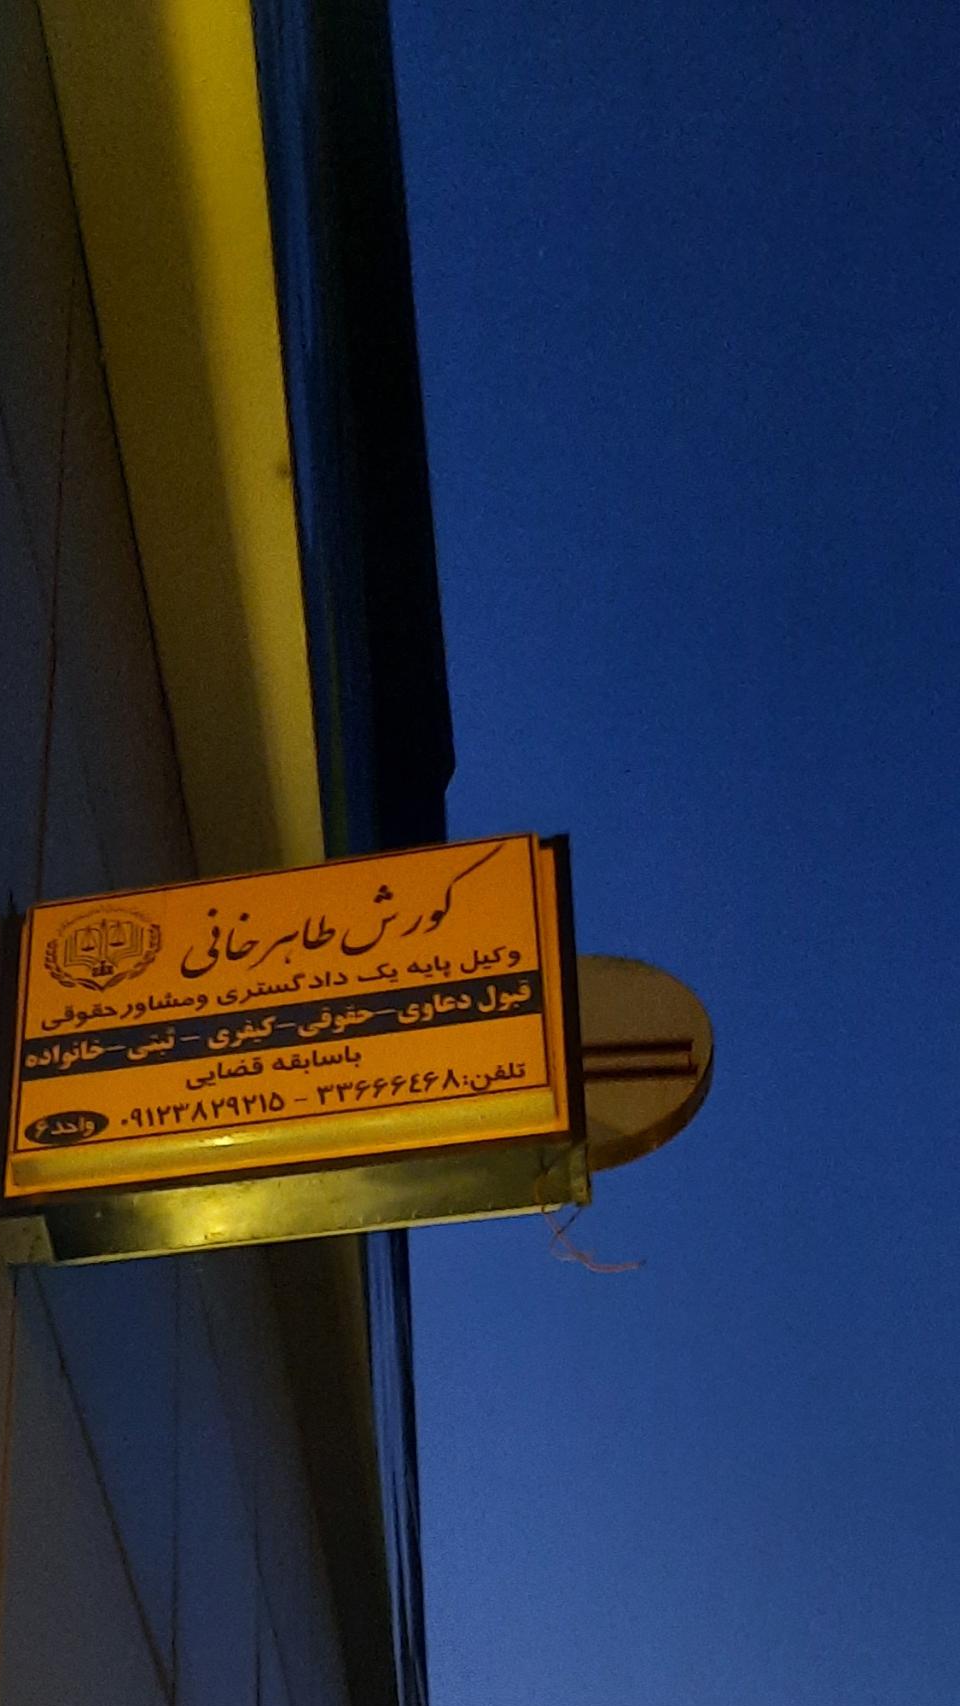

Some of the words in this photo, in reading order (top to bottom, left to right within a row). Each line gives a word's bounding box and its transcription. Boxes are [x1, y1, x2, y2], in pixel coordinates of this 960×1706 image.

[341, 841, 504, 956] کورش
[357, 963, 400, 984] یک
[406, 955, 452, 979] پایه
[459, 945, 522, 974] وکیل
[477, 979, 533, 1013] قبول
[41, 1004, 118, 1031] حقوقی
[186, 1055, 265, 1091] قضایی
[51, 1116, 96, 1138] واحد
